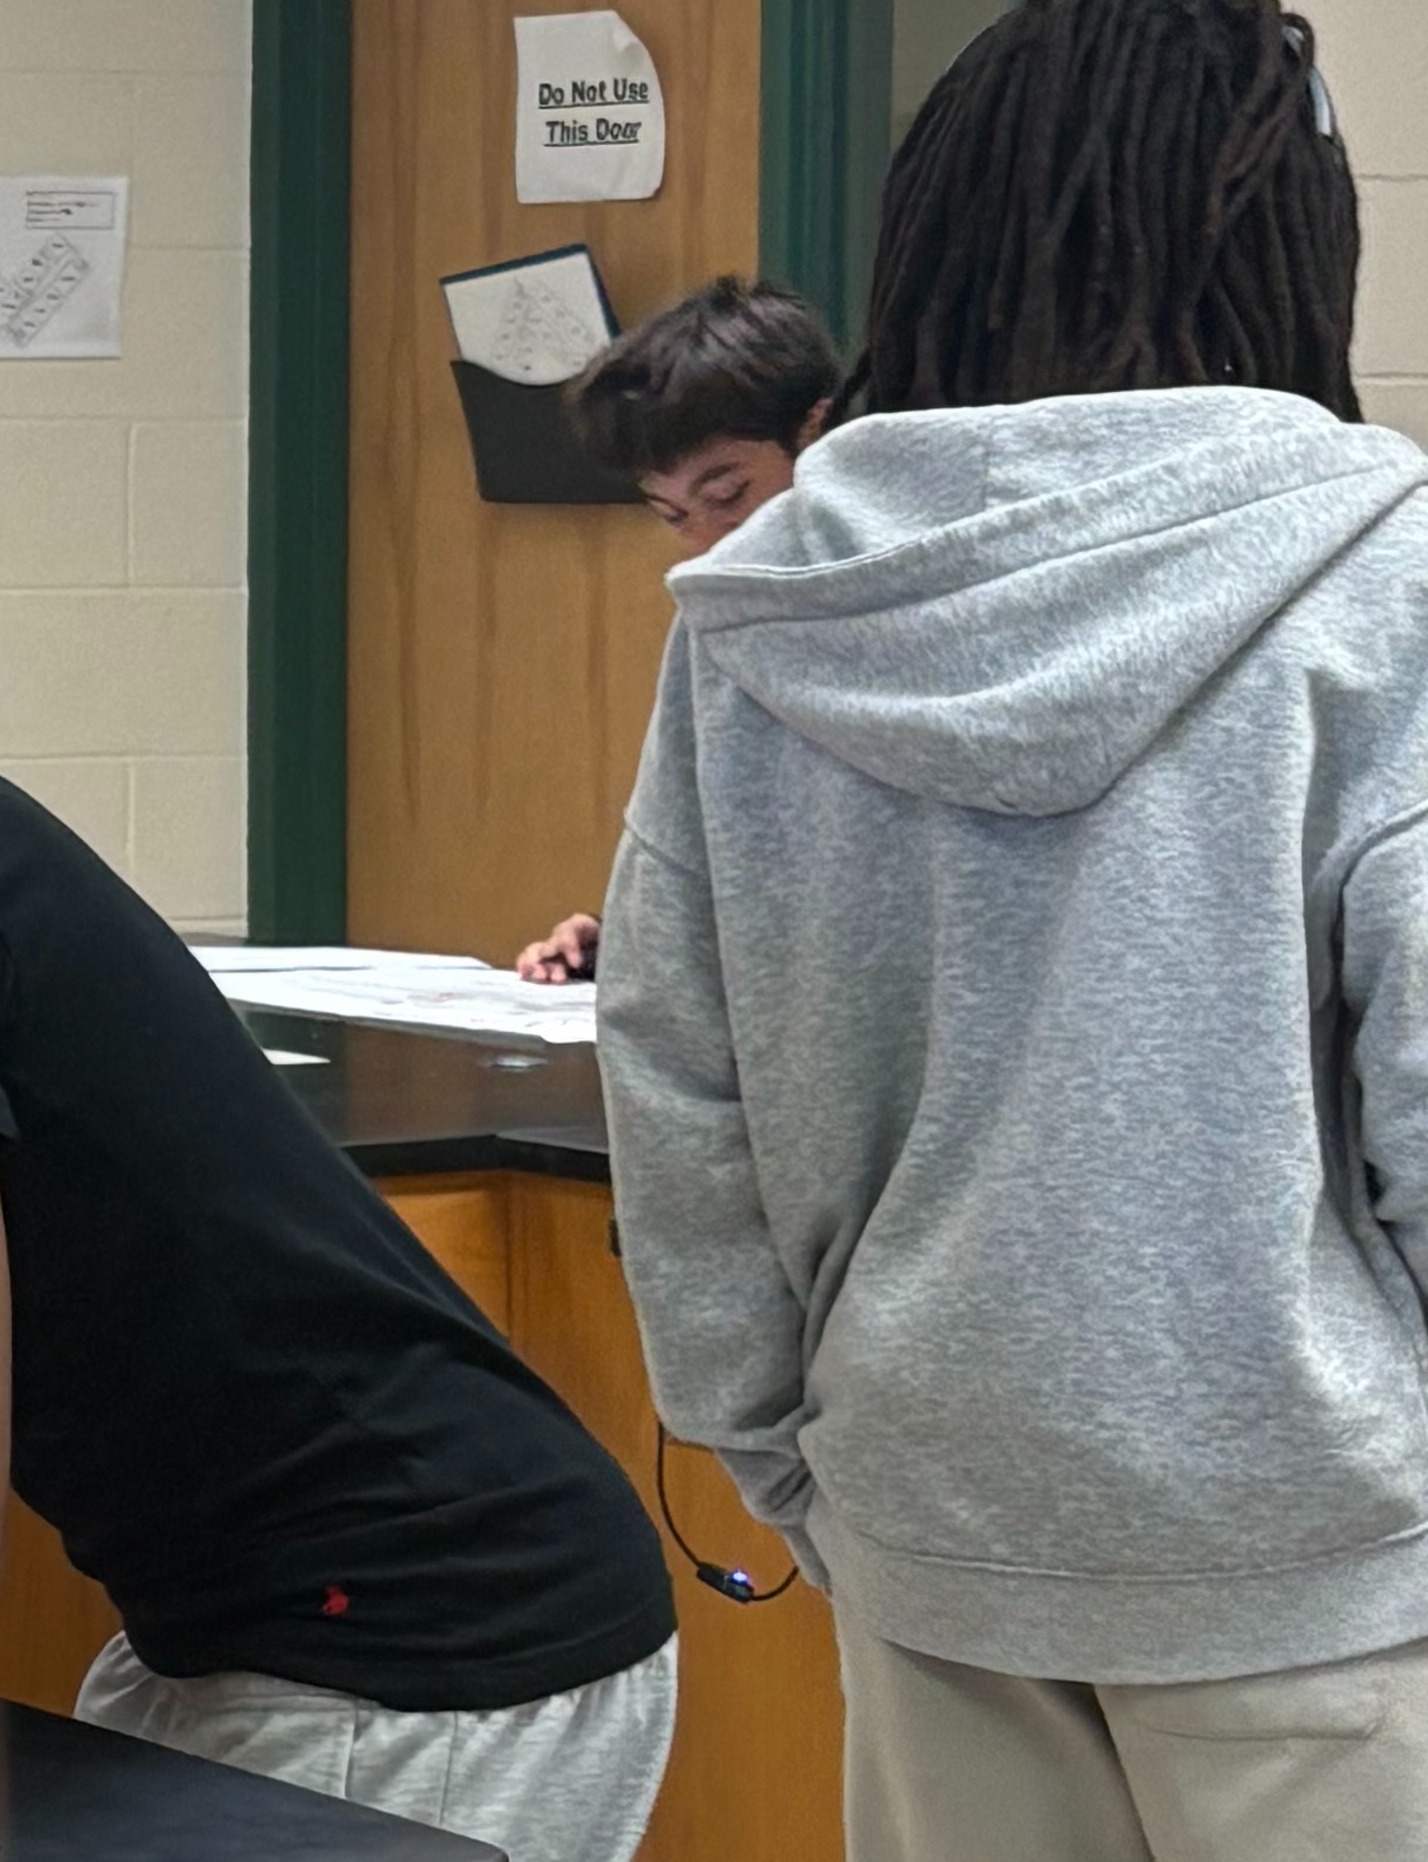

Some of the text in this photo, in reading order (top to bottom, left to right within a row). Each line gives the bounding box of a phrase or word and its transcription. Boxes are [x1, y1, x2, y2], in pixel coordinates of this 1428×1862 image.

[538, 77, 649, 106] Do Not Use
[545, 117, 642, 144] This Door
